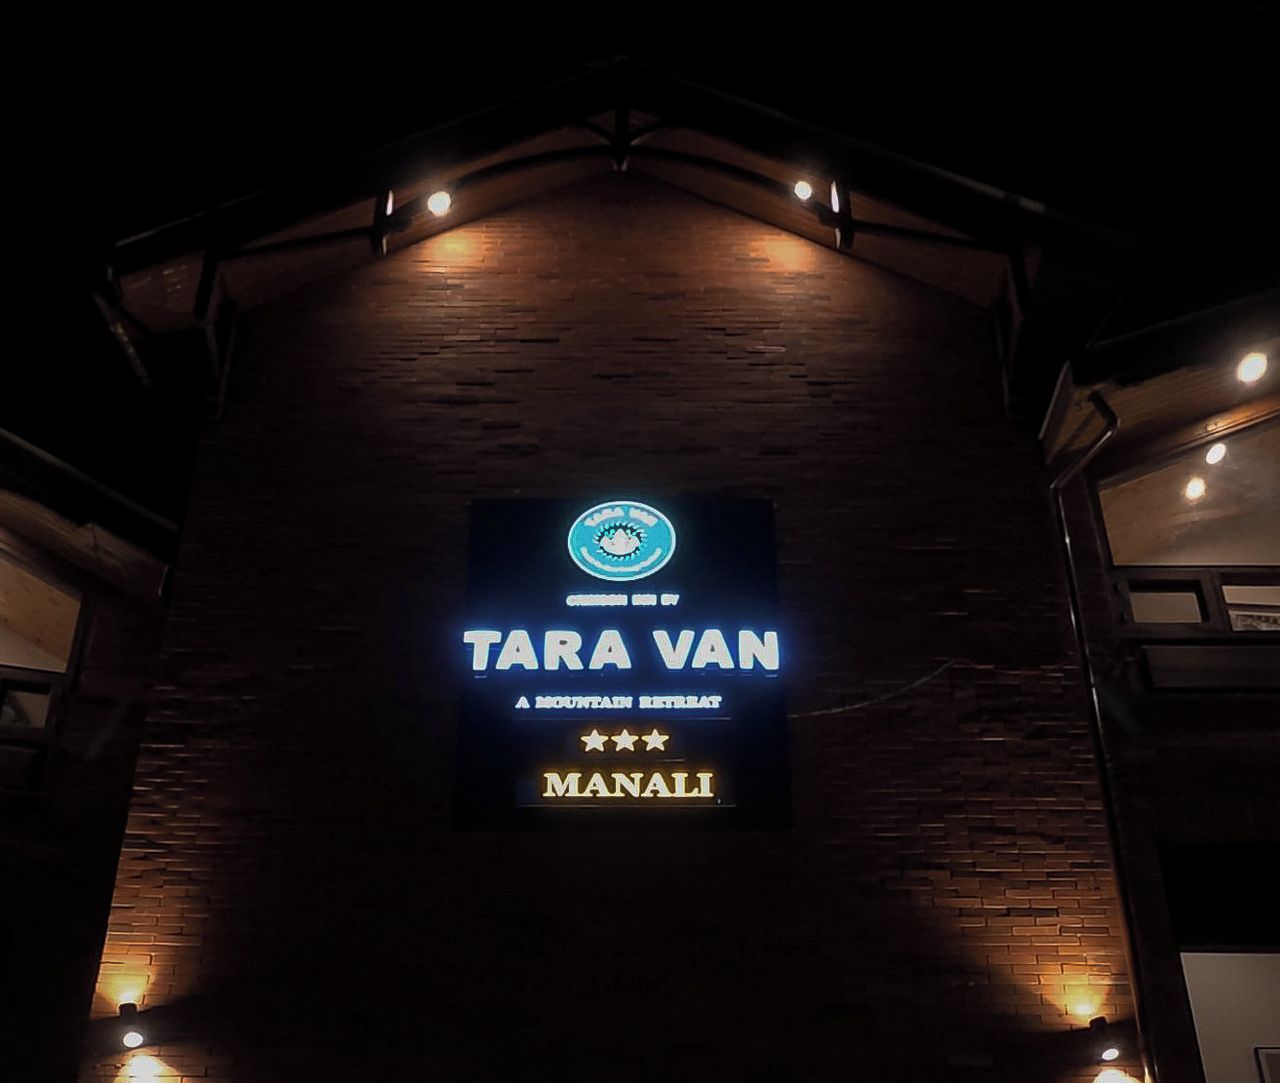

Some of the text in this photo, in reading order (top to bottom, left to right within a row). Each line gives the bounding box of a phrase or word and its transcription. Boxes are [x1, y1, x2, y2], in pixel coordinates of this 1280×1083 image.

[463, 629, 780, 670] TARA VAN
[515, 696, 722, 708] A MOUNTAIN RETREAT
[543, 772, 714, 797] MANALI
